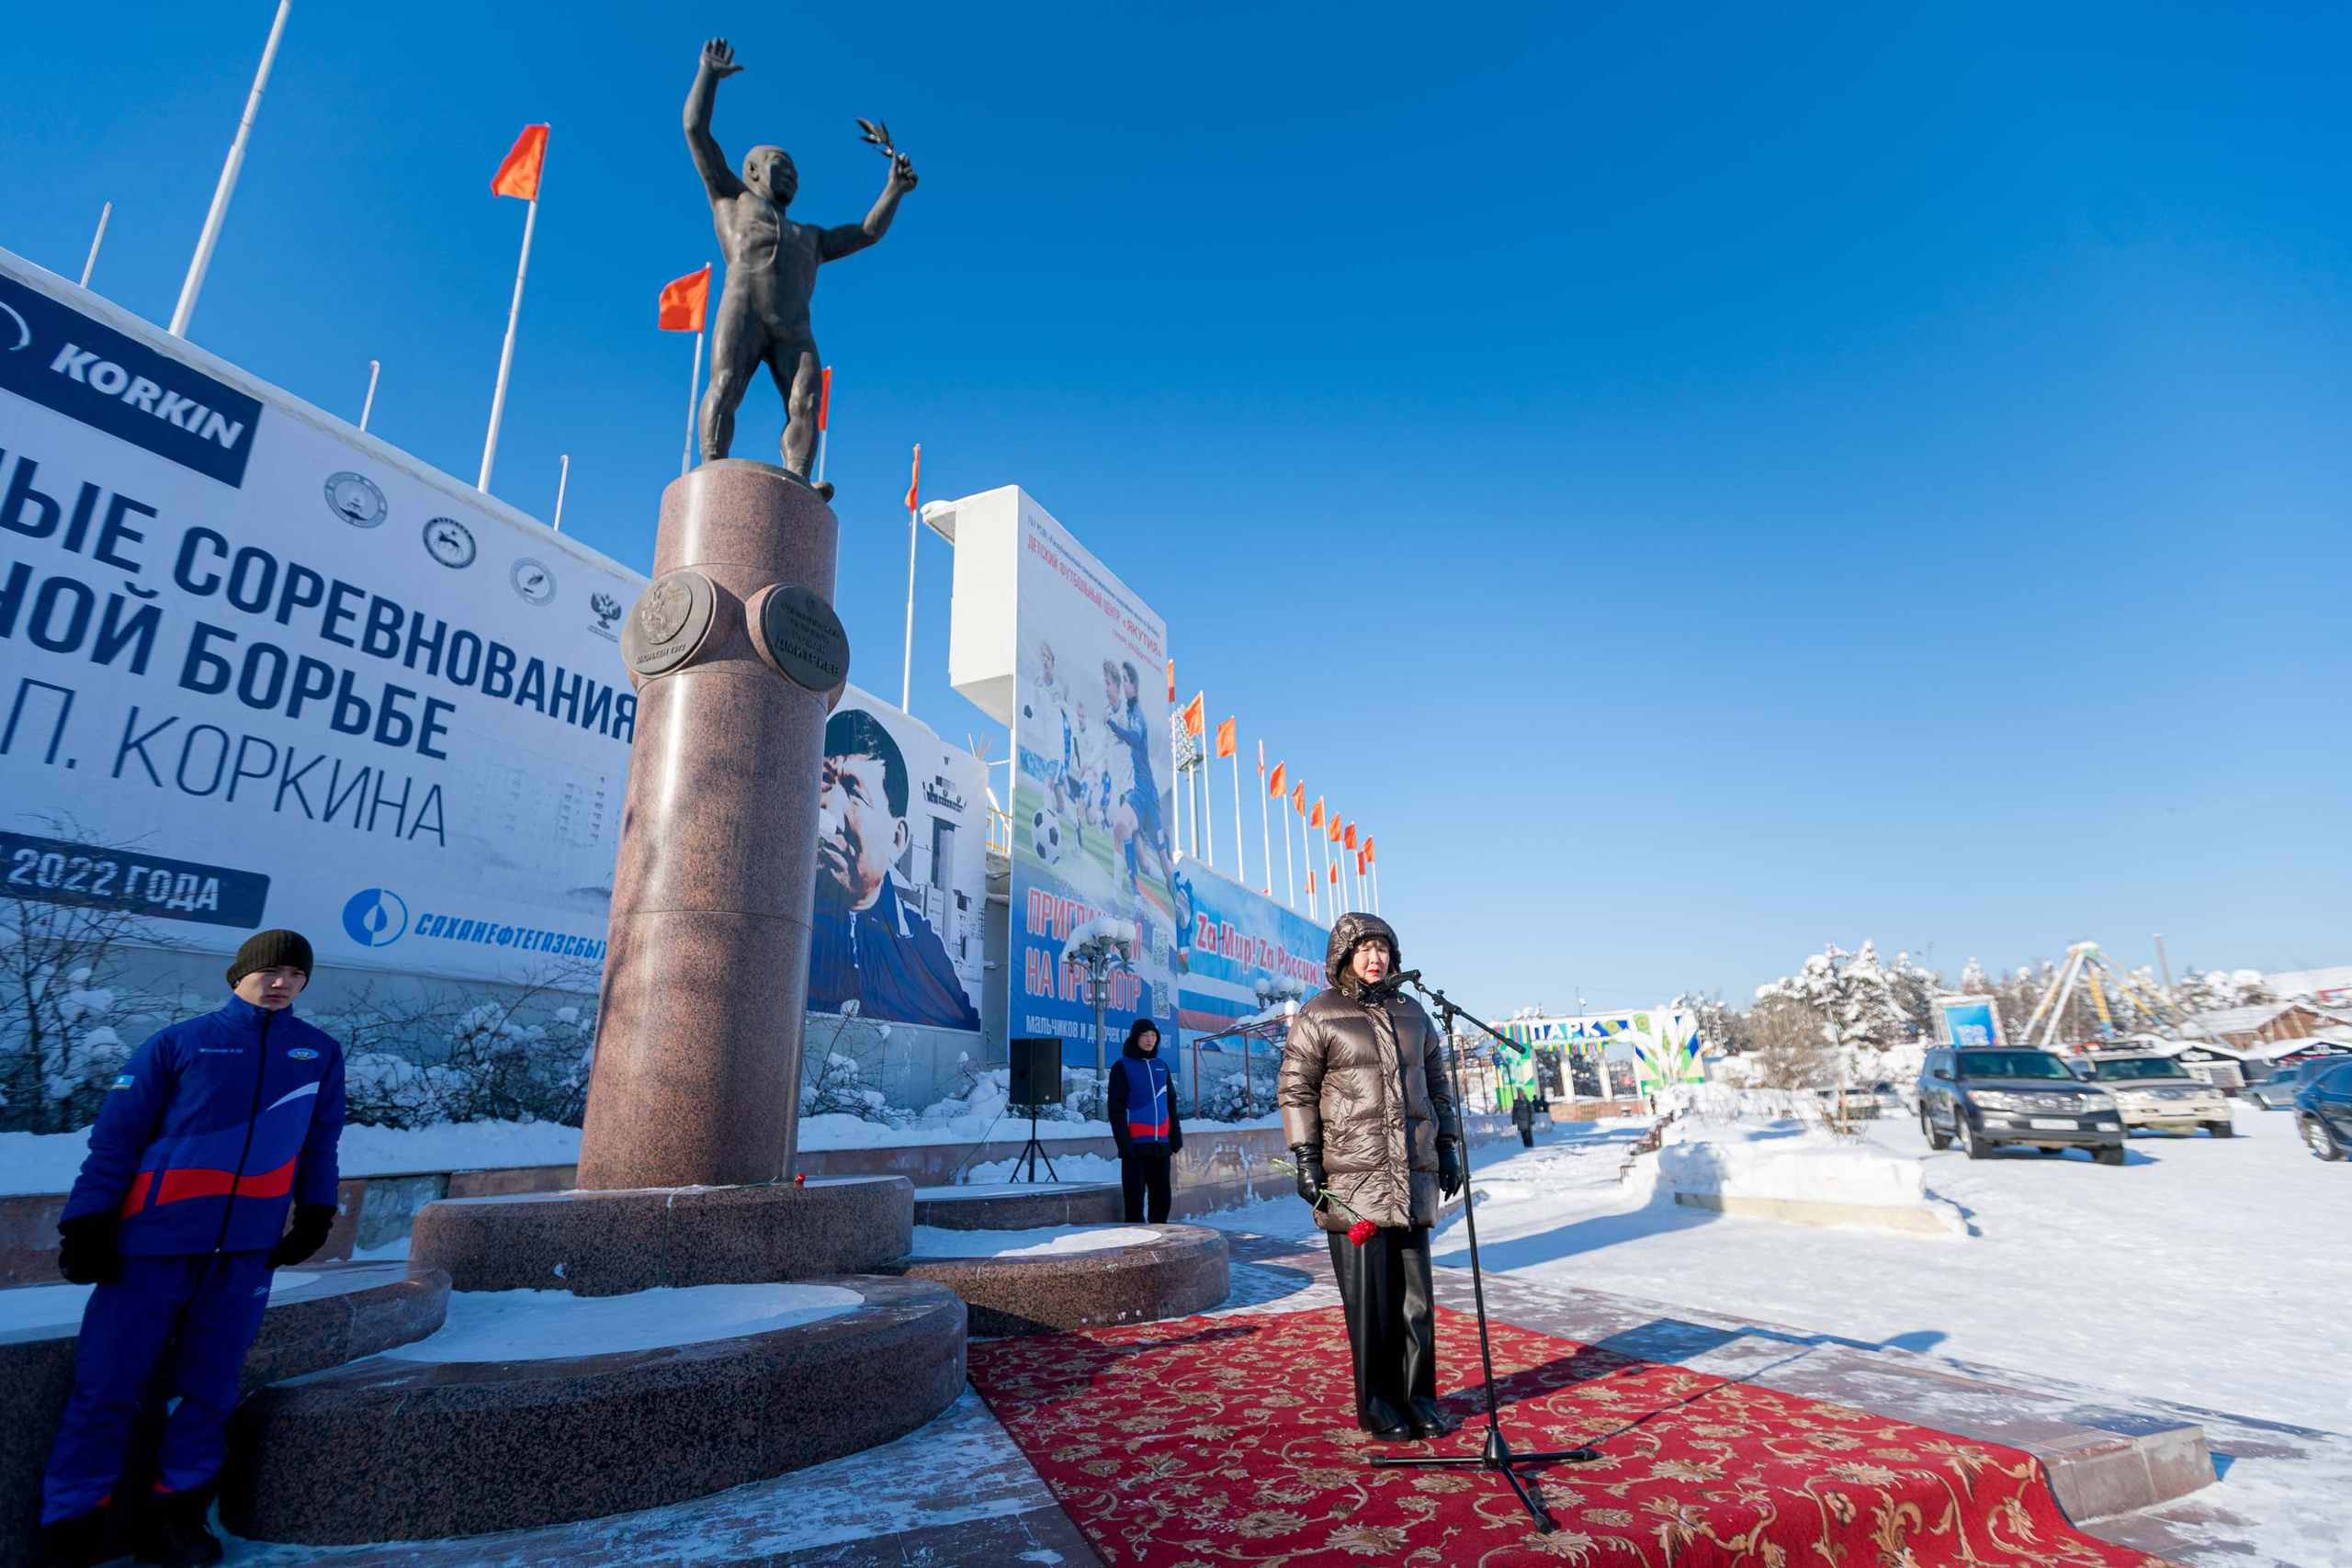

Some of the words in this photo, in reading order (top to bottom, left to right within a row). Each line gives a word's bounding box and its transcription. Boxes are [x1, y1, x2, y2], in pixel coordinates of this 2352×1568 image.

[50, 342, 244, 450] KORKIN
[0, 447, 159, 575] ЫЕ
[173, 525, 638, 745] СОРЕВНОВАНИЯ
[1028, 533, 1058, 571] ДЕТСКИЙ
[1059, 561, 1102, 610] ФУТБОЛЬНЫЙ
[178, 619, 457, 761] БОРЬБЕ
[774, 636, 840, 678] ДМИТРИЕВ
[111, 705, 447, 848] КОРКИНА
[6, 848, 119, 897] 2022
[123, 865, 220, 912] ГОДА
[1027, 888, 1142, 961] ПРИГМ
[1220, 921, 1257, 974] Мир!
[1026, 946, 1054, 998] НА
[1058, 956, 1142, 1012] ПРОМОТР
[1080, 1021, 1086, 1040] и
[1087, 1023, 1121, 1044] дочек
[1529, 1021, 1601, 1042] ПАРК
